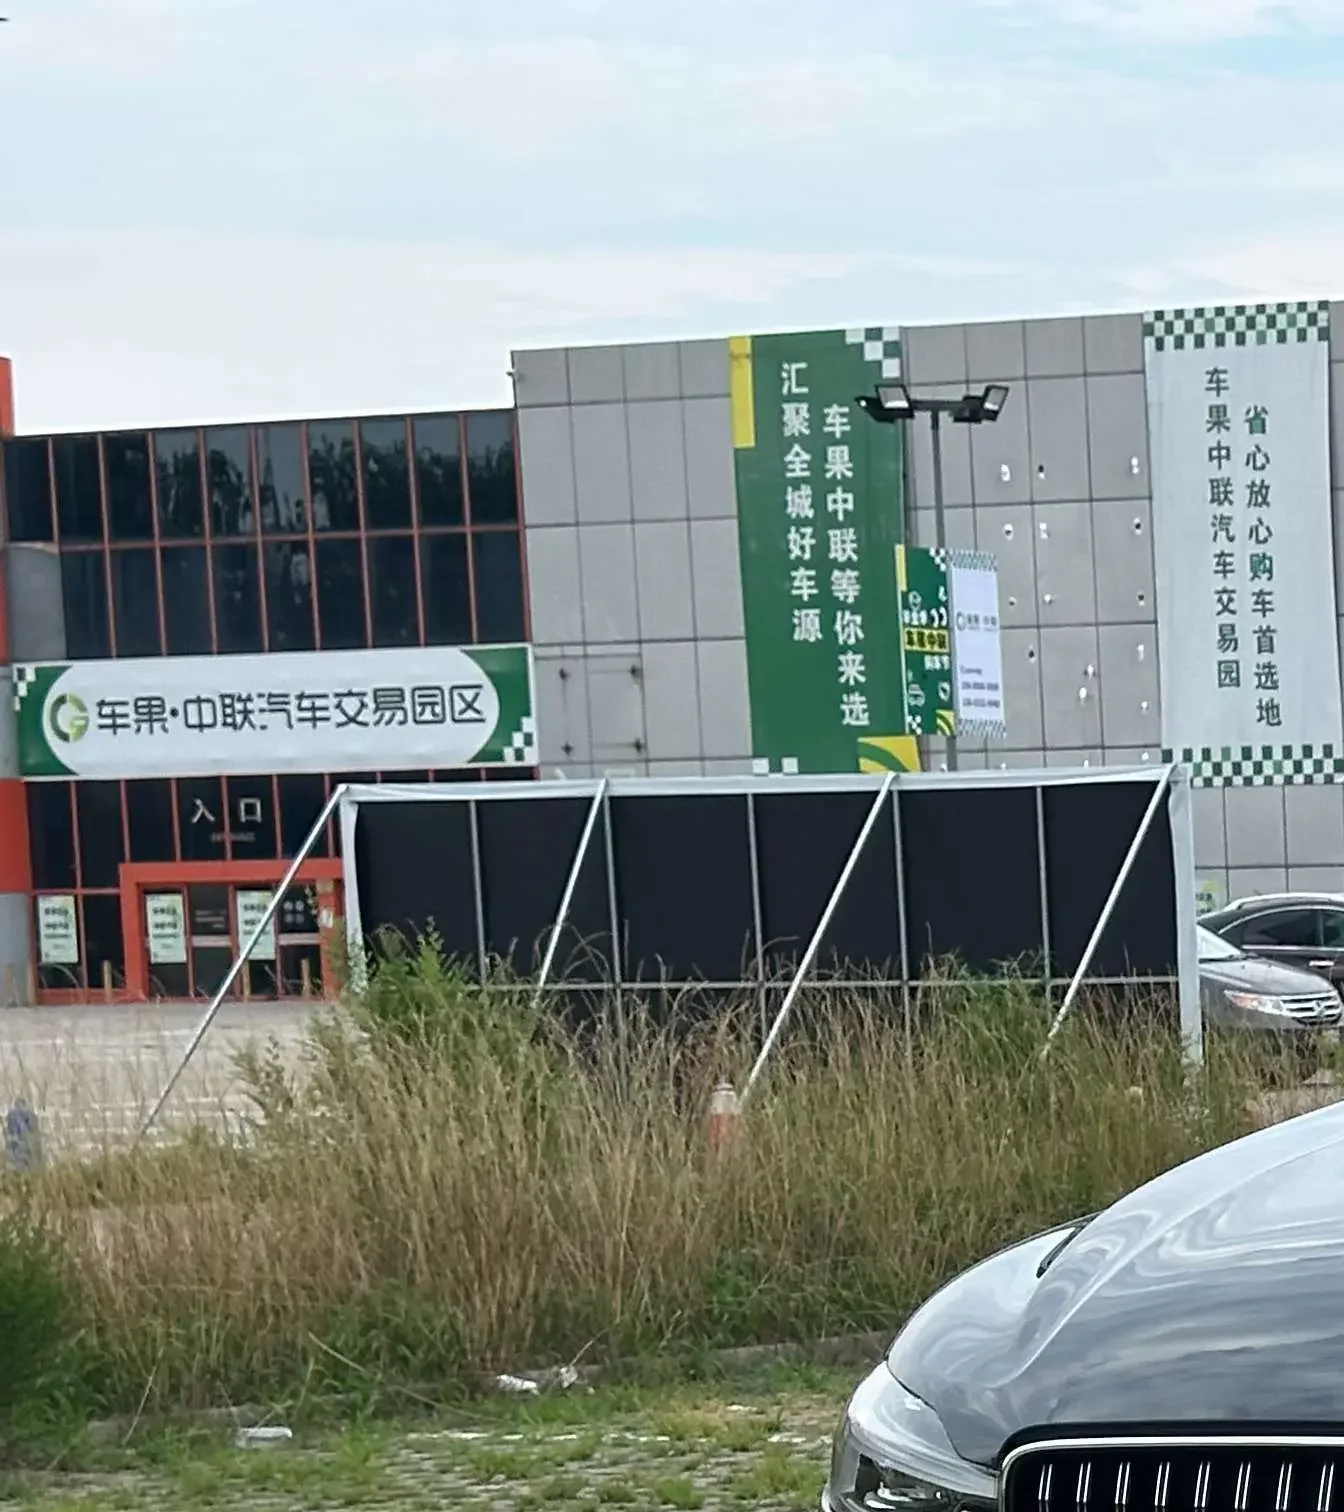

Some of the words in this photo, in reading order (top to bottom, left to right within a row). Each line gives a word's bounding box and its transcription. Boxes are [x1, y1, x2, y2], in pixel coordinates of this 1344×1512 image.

[781, 361, 822, 644] 汇聚全城好车源
[822, 402, 871, 728] 车果中联等你来选
[1204, 366, 1241, 689] 车果中联汽车交易园
[1244, 404, 1283, 727] 省心放心购车首选地
[192, 797, 263, 824] 入口
